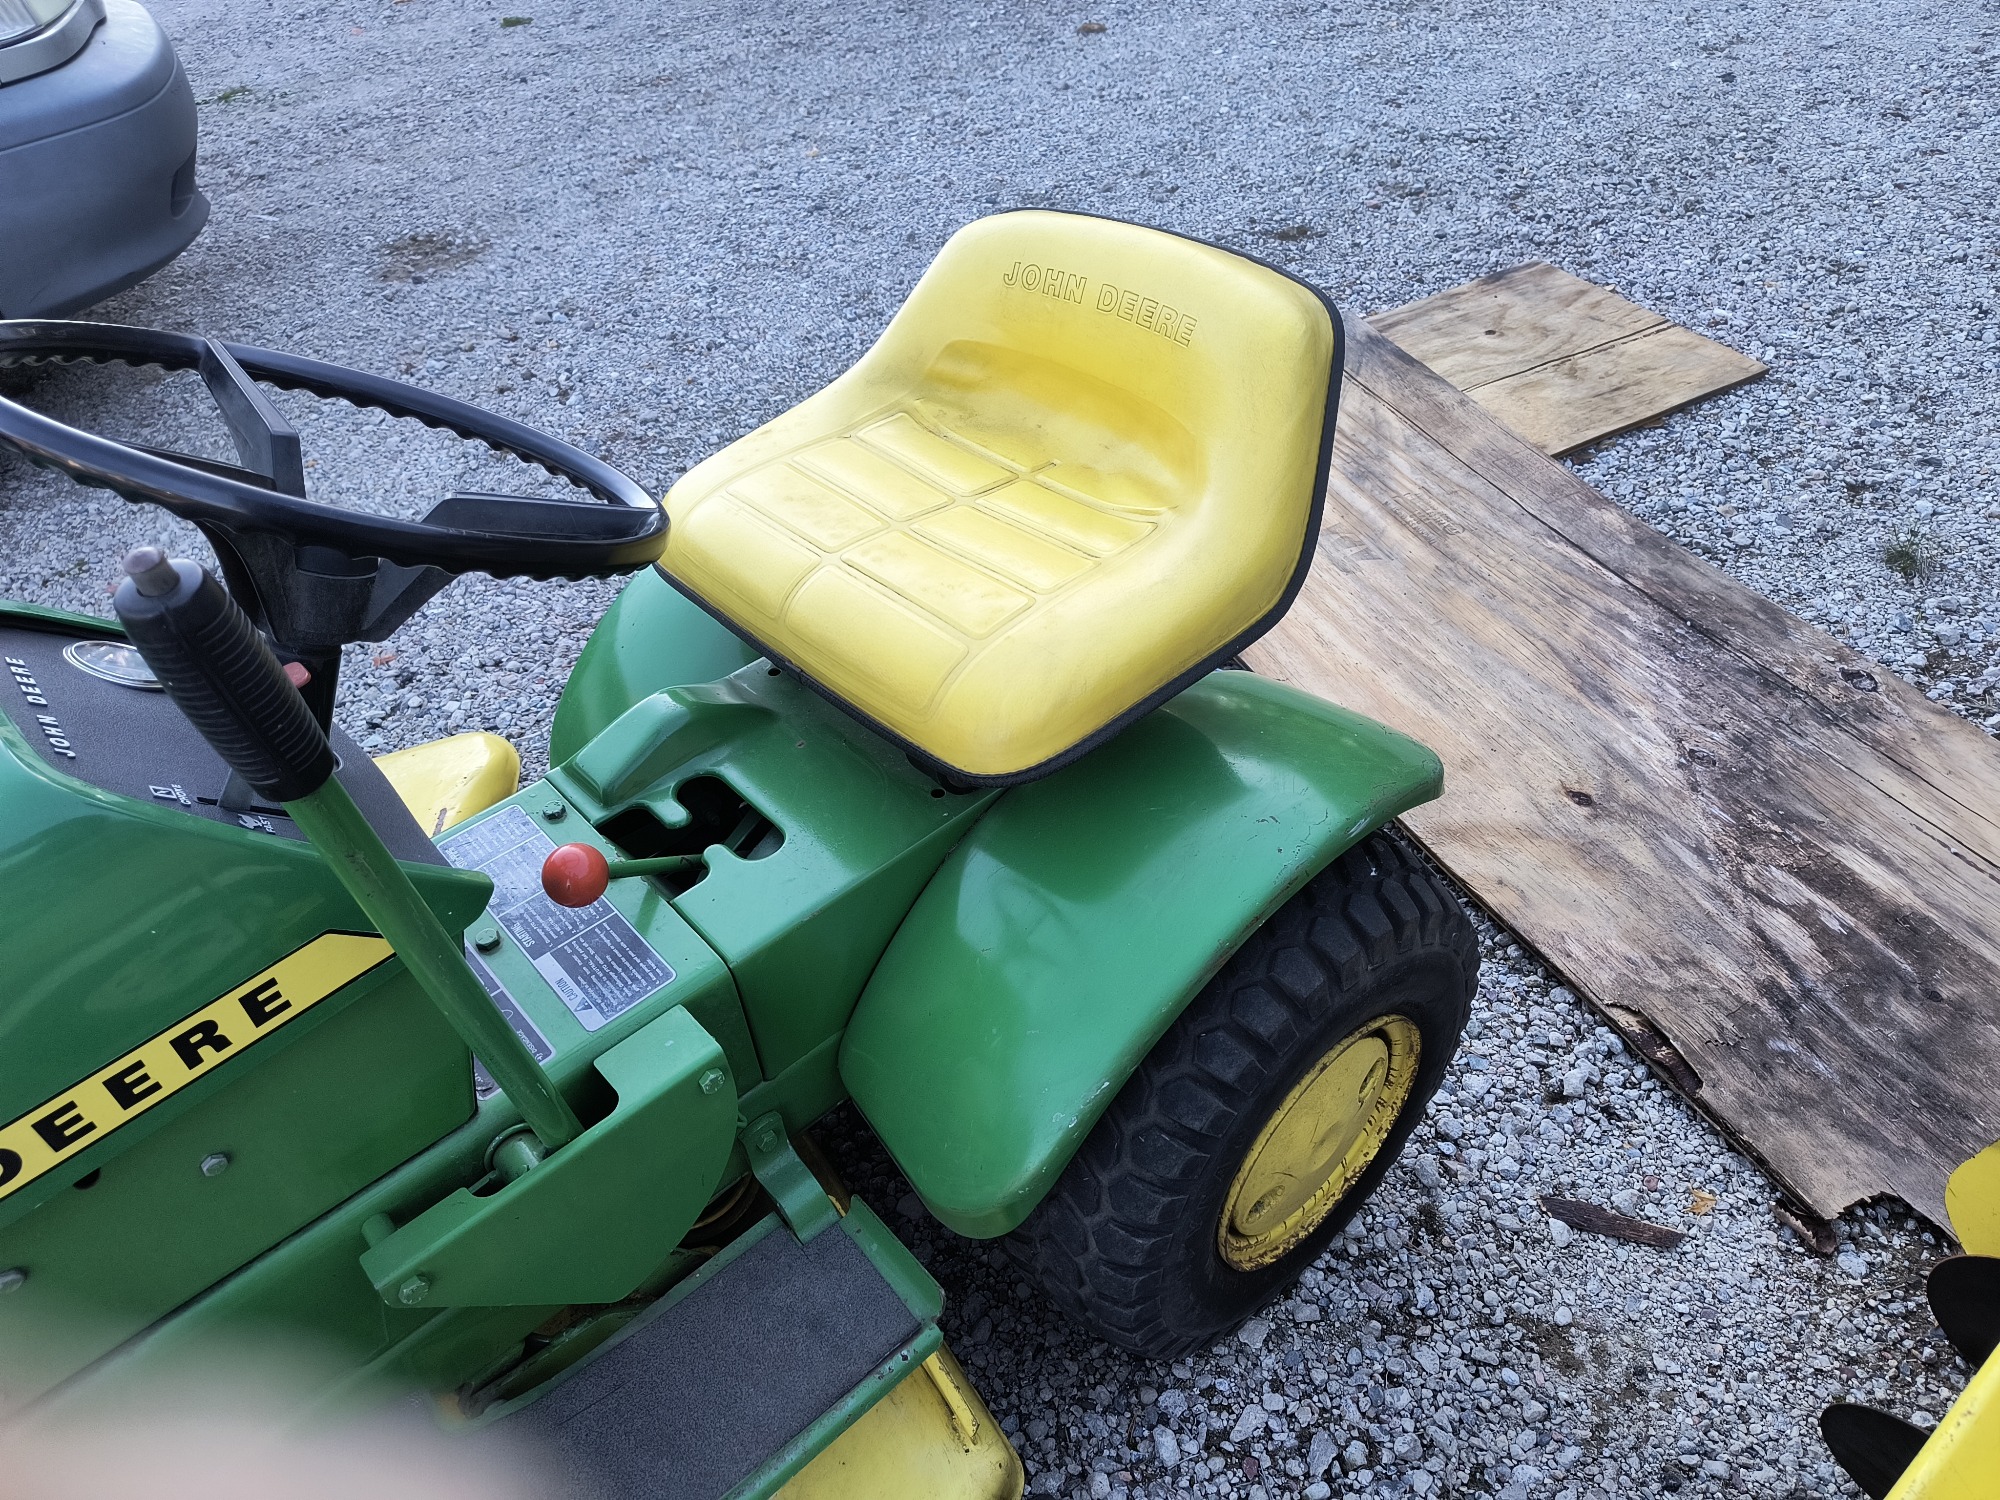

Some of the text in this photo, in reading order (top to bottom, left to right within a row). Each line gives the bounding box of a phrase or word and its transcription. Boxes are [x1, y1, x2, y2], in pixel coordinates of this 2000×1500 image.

[1003, 261, 1198, 348] JOHN DEERE
[4, 656, 76, 758] JOHN DEERE
[171, 783, 192, 806] CHOKE
[257, 815, 276, 834] FAST
[509, 921, 536, 948] STARTING
[554, 976, 578, 1001] CAUTION
[516, 1029, 538, 1054] DISENGAGE
